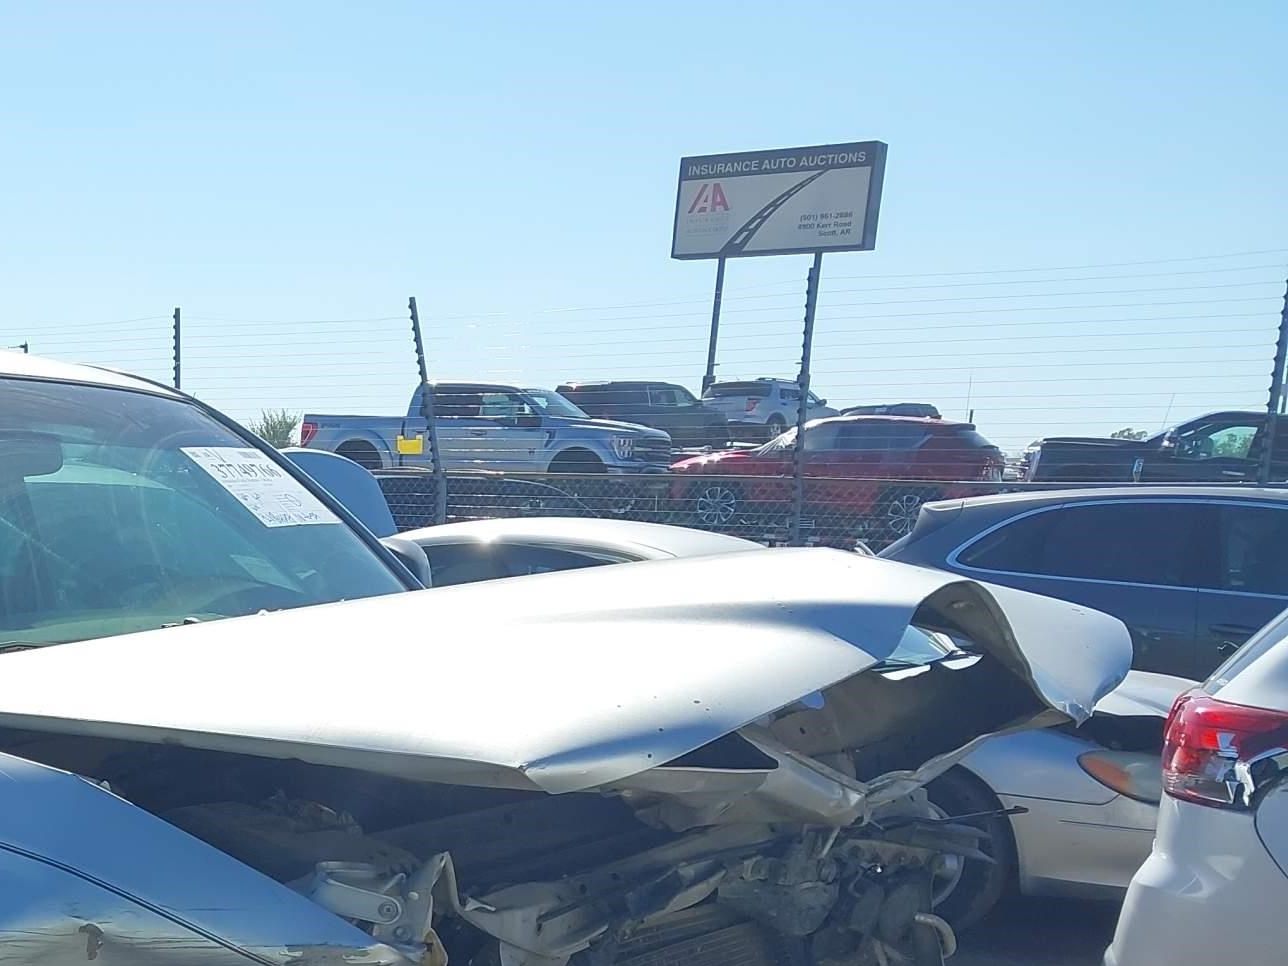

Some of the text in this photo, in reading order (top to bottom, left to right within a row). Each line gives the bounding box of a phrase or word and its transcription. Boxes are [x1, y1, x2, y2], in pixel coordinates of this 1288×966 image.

[688, 151, 866, 176] INSURANCE AUTO AUCTIONS
[833, 220, 852, 228] Road
